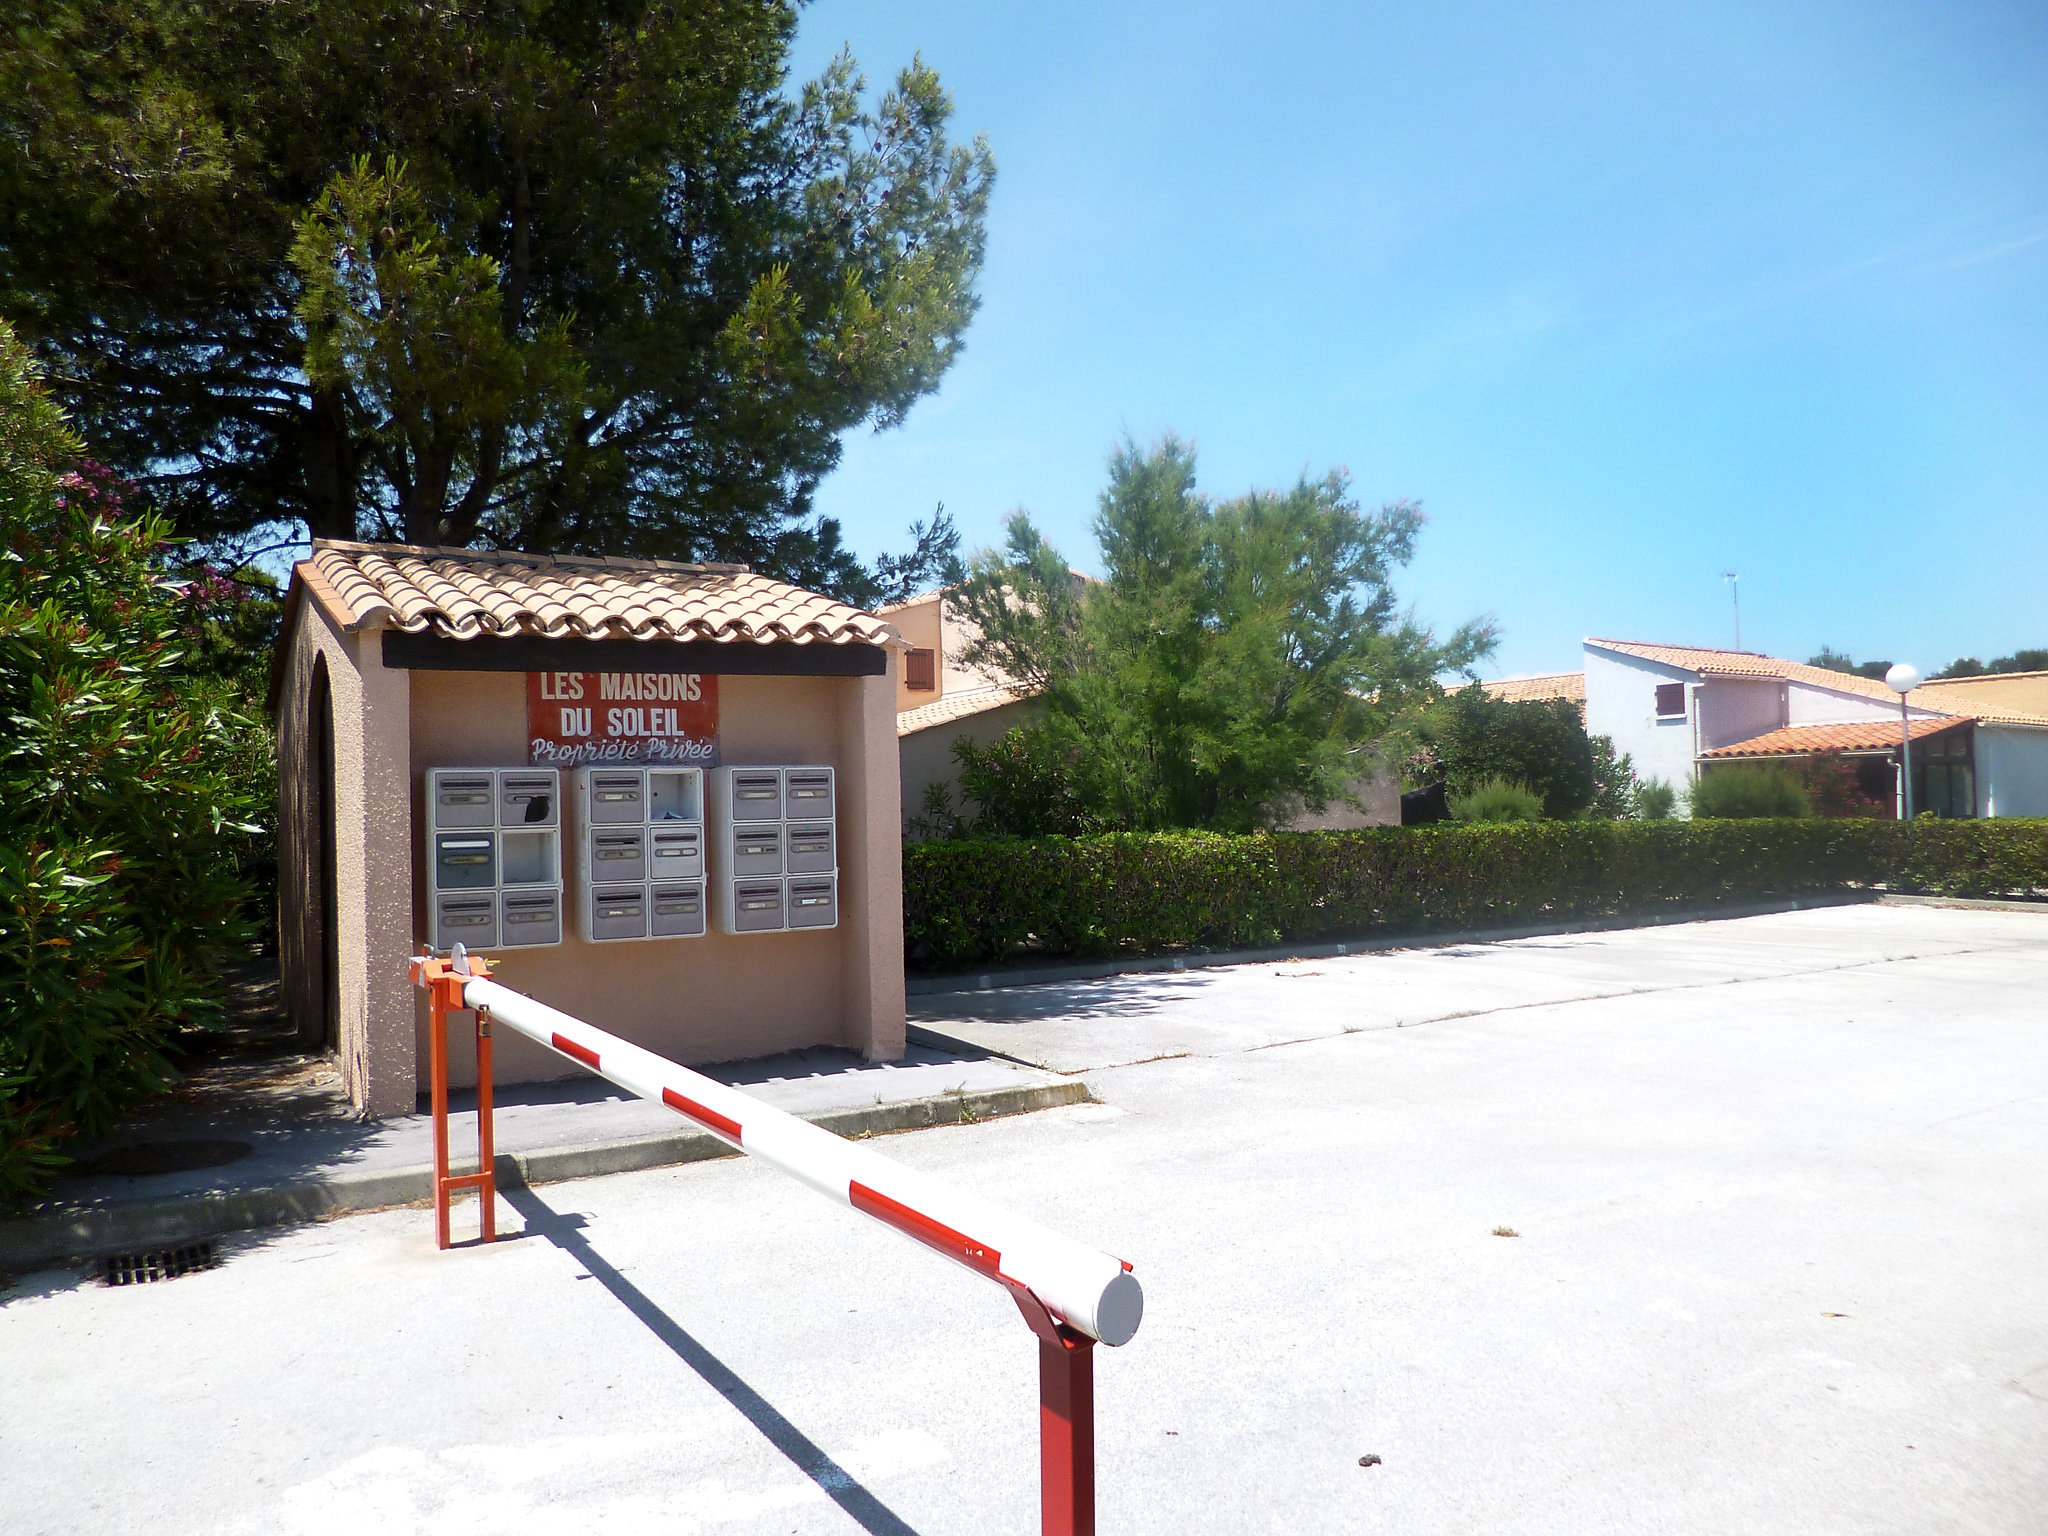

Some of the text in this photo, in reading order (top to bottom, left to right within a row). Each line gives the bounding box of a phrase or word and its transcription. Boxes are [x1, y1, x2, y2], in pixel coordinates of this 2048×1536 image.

[540, 672, 702, 702] LES MAISONS
[560, 707, 685, 737] DU SOLEIL
[531, 736, 714, 767] Propriété Privée
